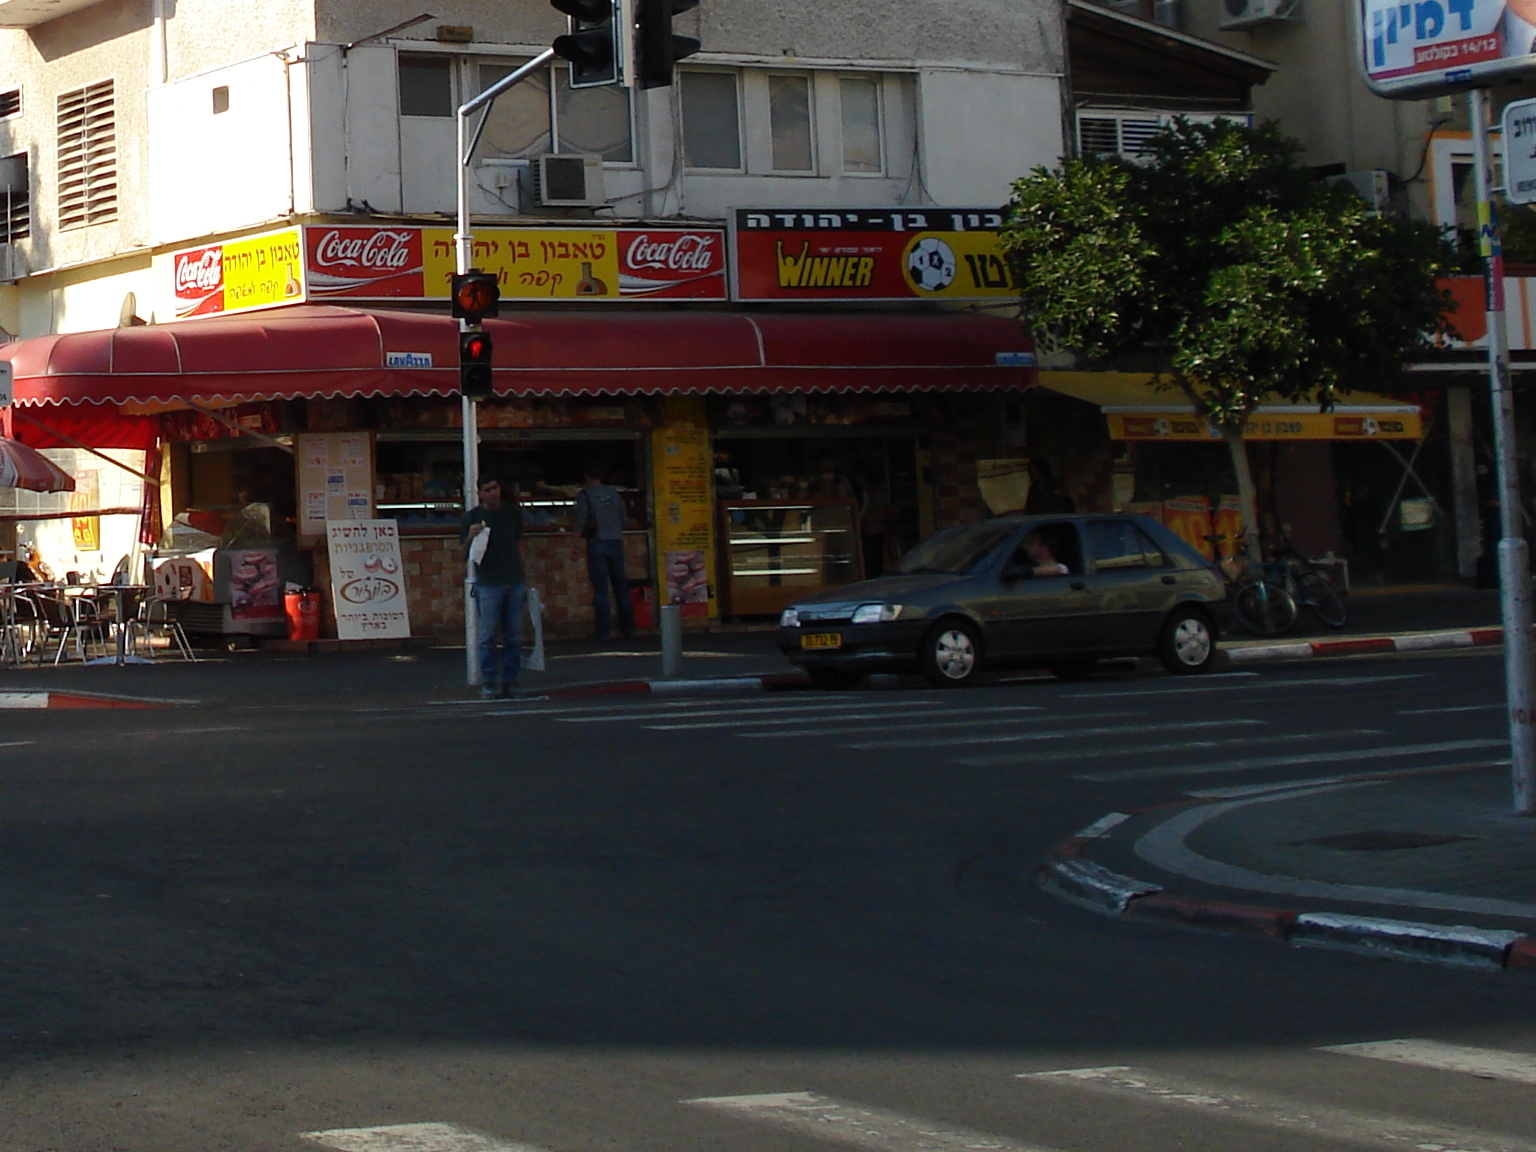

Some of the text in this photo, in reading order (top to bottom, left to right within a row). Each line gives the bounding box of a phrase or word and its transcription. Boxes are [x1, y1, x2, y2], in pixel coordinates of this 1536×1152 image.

[224, 242, 300, 273] טאבון בן יהודה
[316, 230, 413, 267] Coca-Cola
[433, 238, 606, 264] טאבון בן יהה
[626, 234, 715, 269] Coca-Cola
[776, 240, 875, 287] WINNER
[519, 270, 563, 295] קפה
[332, 523, 394, 539] כאן להשיג
[340, 567, 354, 579] של
